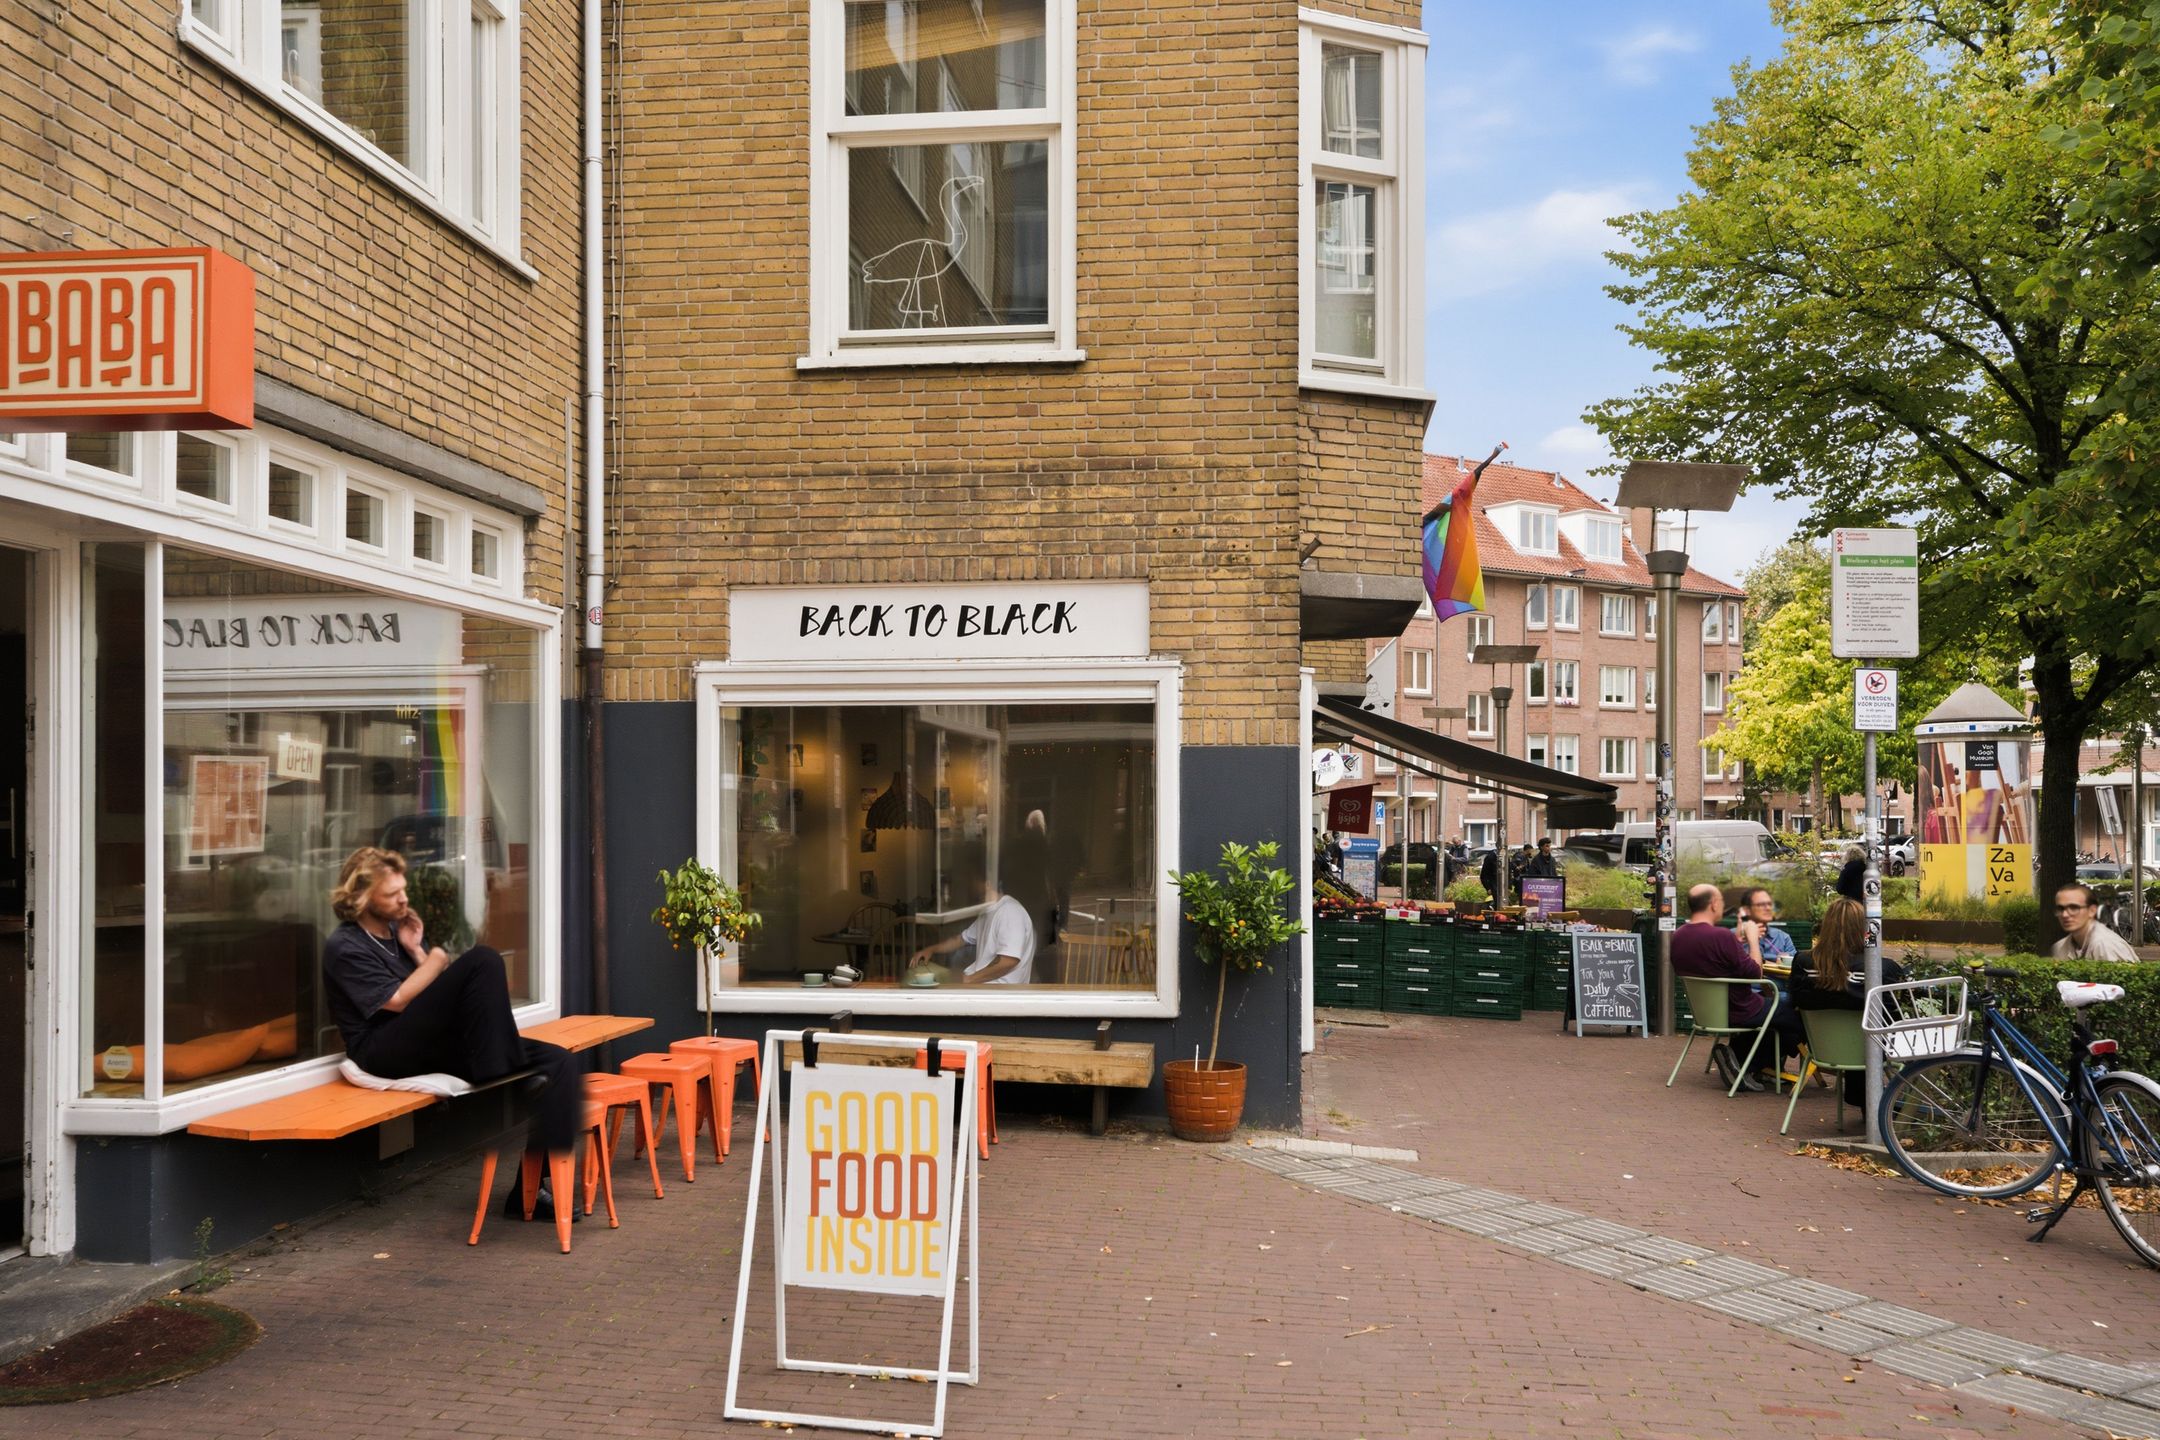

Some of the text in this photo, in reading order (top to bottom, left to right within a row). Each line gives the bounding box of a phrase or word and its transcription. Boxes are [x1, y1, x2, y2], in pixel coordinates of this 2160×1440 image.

[0, 276, 176, 389] BABA
[799, 601, 1078, 638] BACK TO BLACK
[286, 745, 314, 774] OPEN
[1990, 847, 2015, 863] Za
[1990, 866, 2015, 882] Va
[1583, 982, 1610, 997] Daily
[805, 1091, 939, 1158] GOOD
[810, 1151, 938, 1222] FOOD
[806, 1215, 942, 1279] INSIDE
